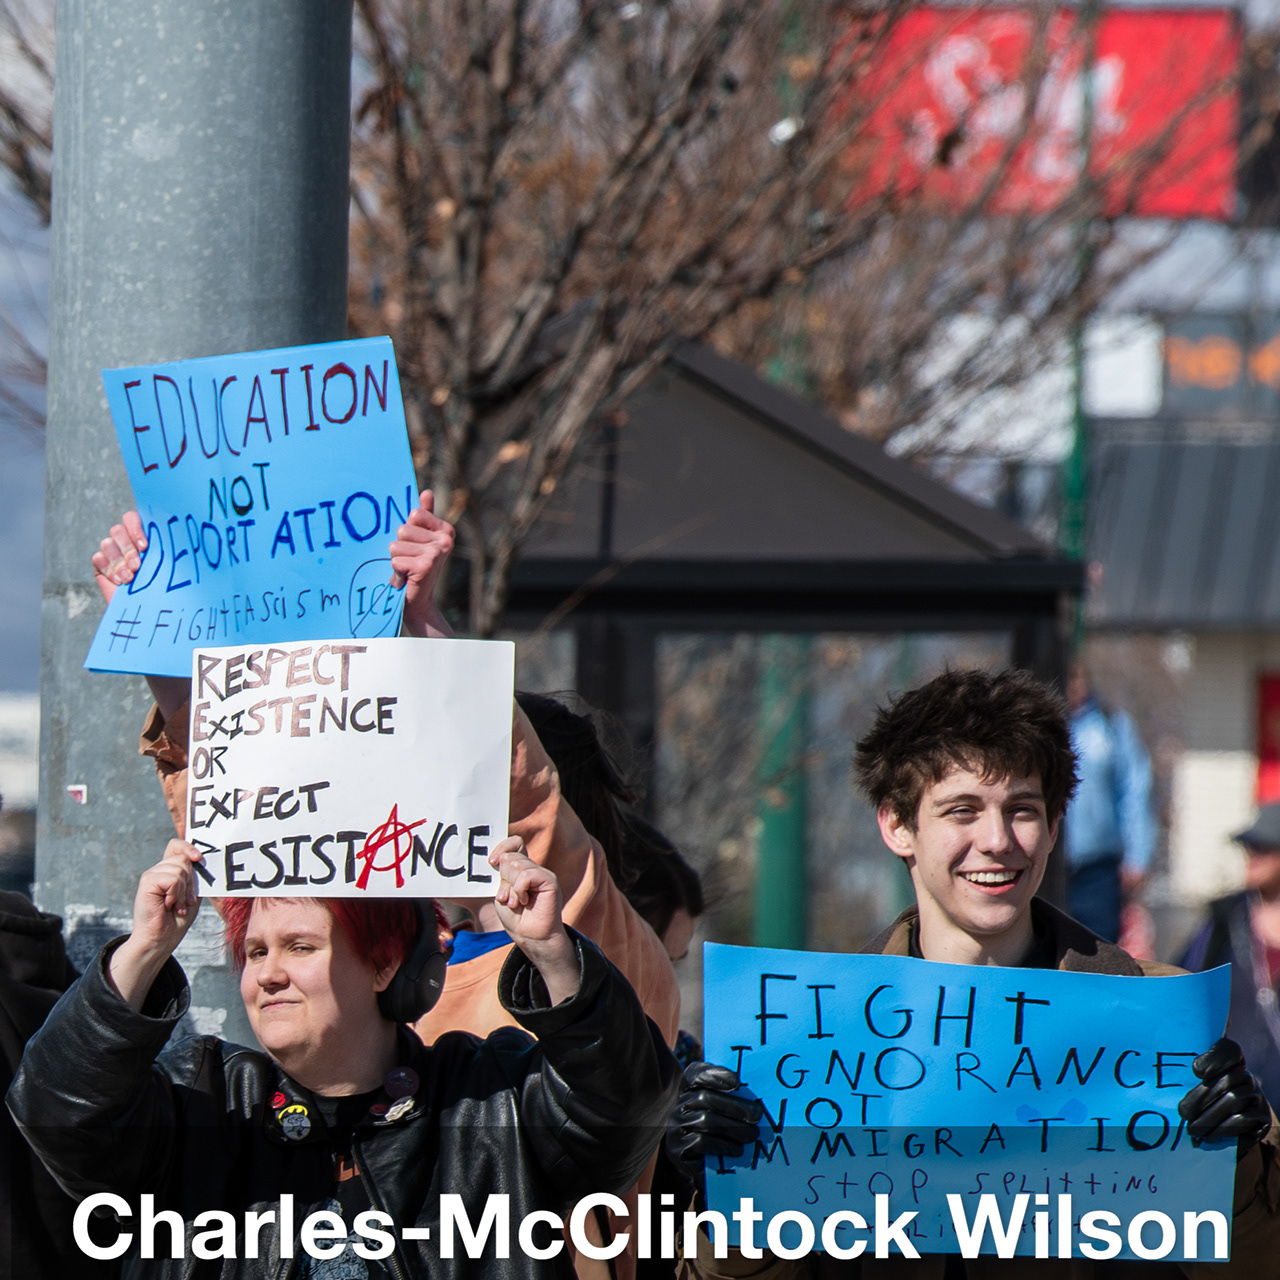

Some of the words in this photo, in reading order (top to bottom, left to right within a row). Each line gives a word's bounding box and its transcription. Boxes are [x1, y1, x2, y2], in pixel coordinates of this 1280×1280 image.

[124, 360, 389, 474] EDUCATION
[209, 462, 270, 520] NOT
[197, 645, 367, 700] RESPECT
[192, 694, 398, 742] EXISTENCE
[192, 746, 228, 779] OR
[190, 780, 330, 828] EXPECT
[191, 803, 493, 891] RESISTANCE
[756, 973, 1050, 1047] FIGHT
[730, 1045, 1198, 1093] IGNORANCE
[755, 1092, 882, 1133] NOT
